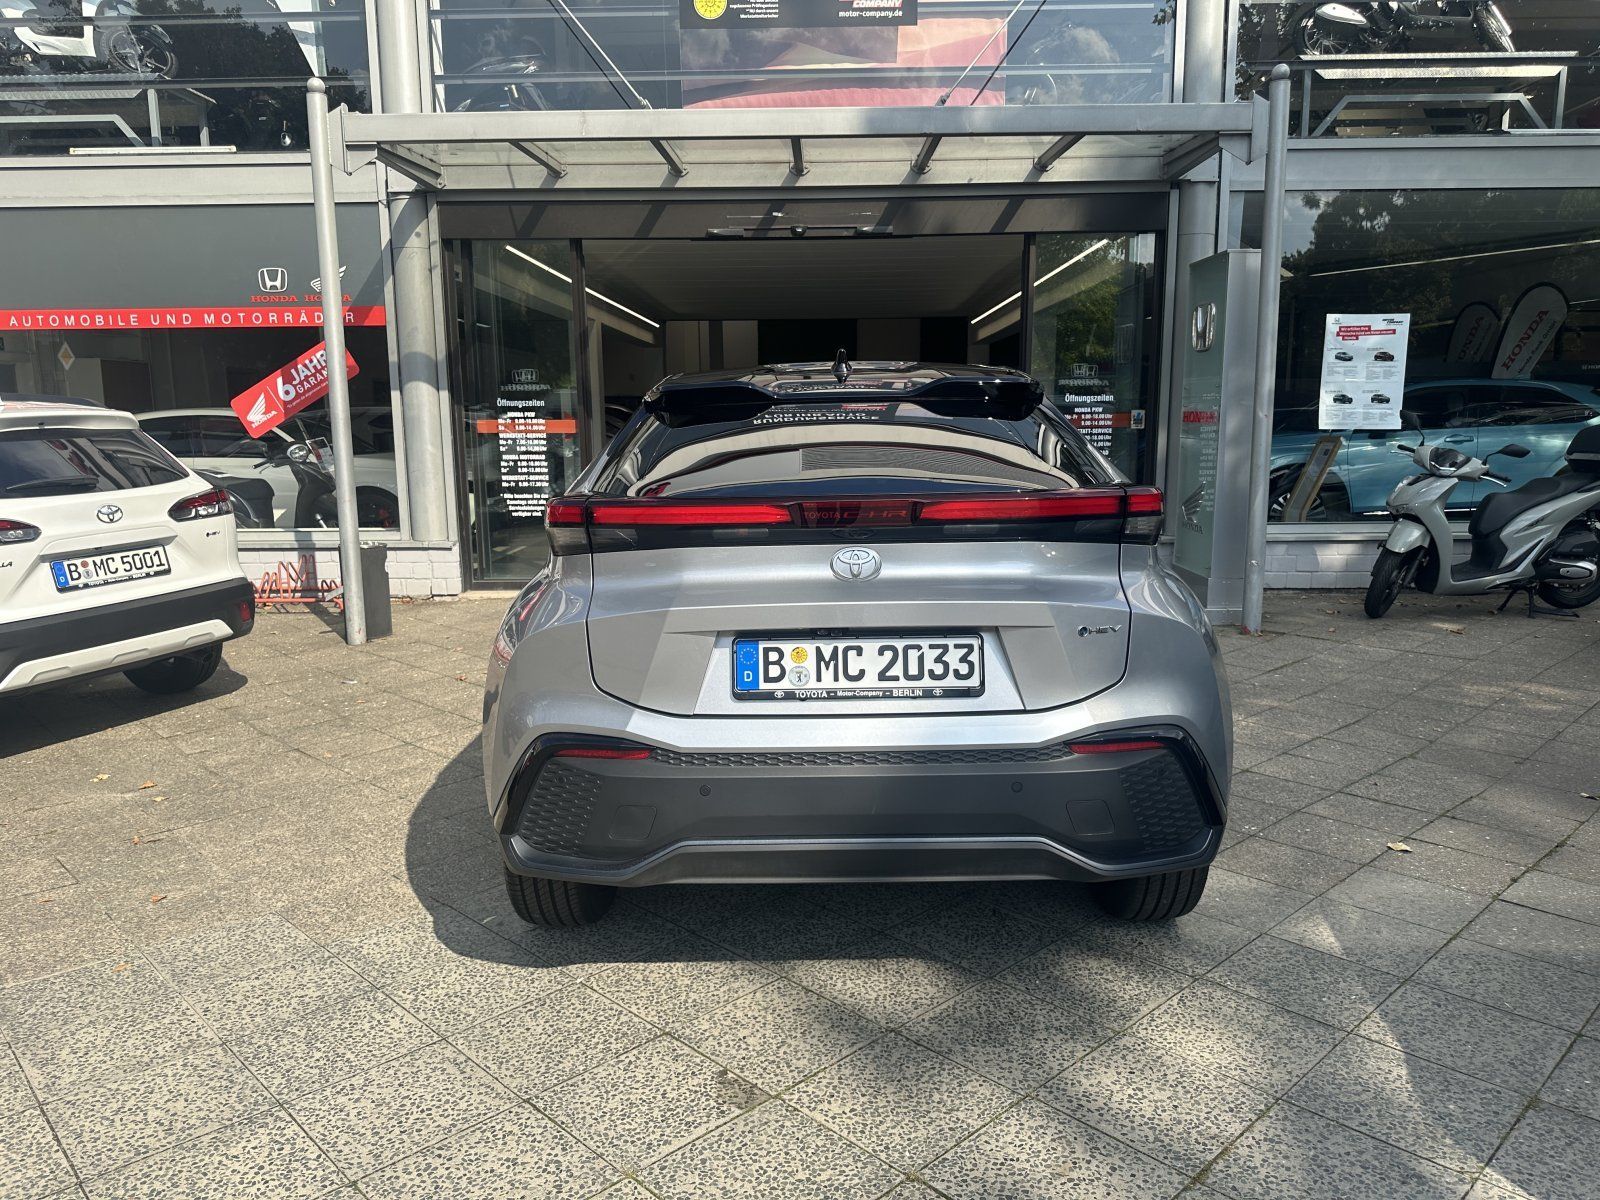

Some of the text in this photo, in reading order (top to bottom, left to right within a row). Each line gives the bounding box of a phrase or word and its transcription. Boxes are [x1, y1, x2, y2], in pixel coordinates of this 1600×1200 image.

[838, 10, 903, 18] motor-company.de
[10, 310, 354, 327] AUTOMOBILE UND MOTORRÄDR
[1502, 310, 1549, 370] HONDA
[276, 350, 327, 401] 6 JAHR
[497, 398, 544, 408] Öffnungszeiten
[1065, 393, 1113, 403] Öffnungszeiten
[251, 411, 278, 428] HONDA
[68, 563, 81, 581] B
[93, 556, 118, 577] MC
[121, 550, 165, 572] 5001
[1089, 625, 1122, 634] HEV
[744, 643, 975, 683] D B MC 2033
[795, 690, 827, 698] TOYOTA
